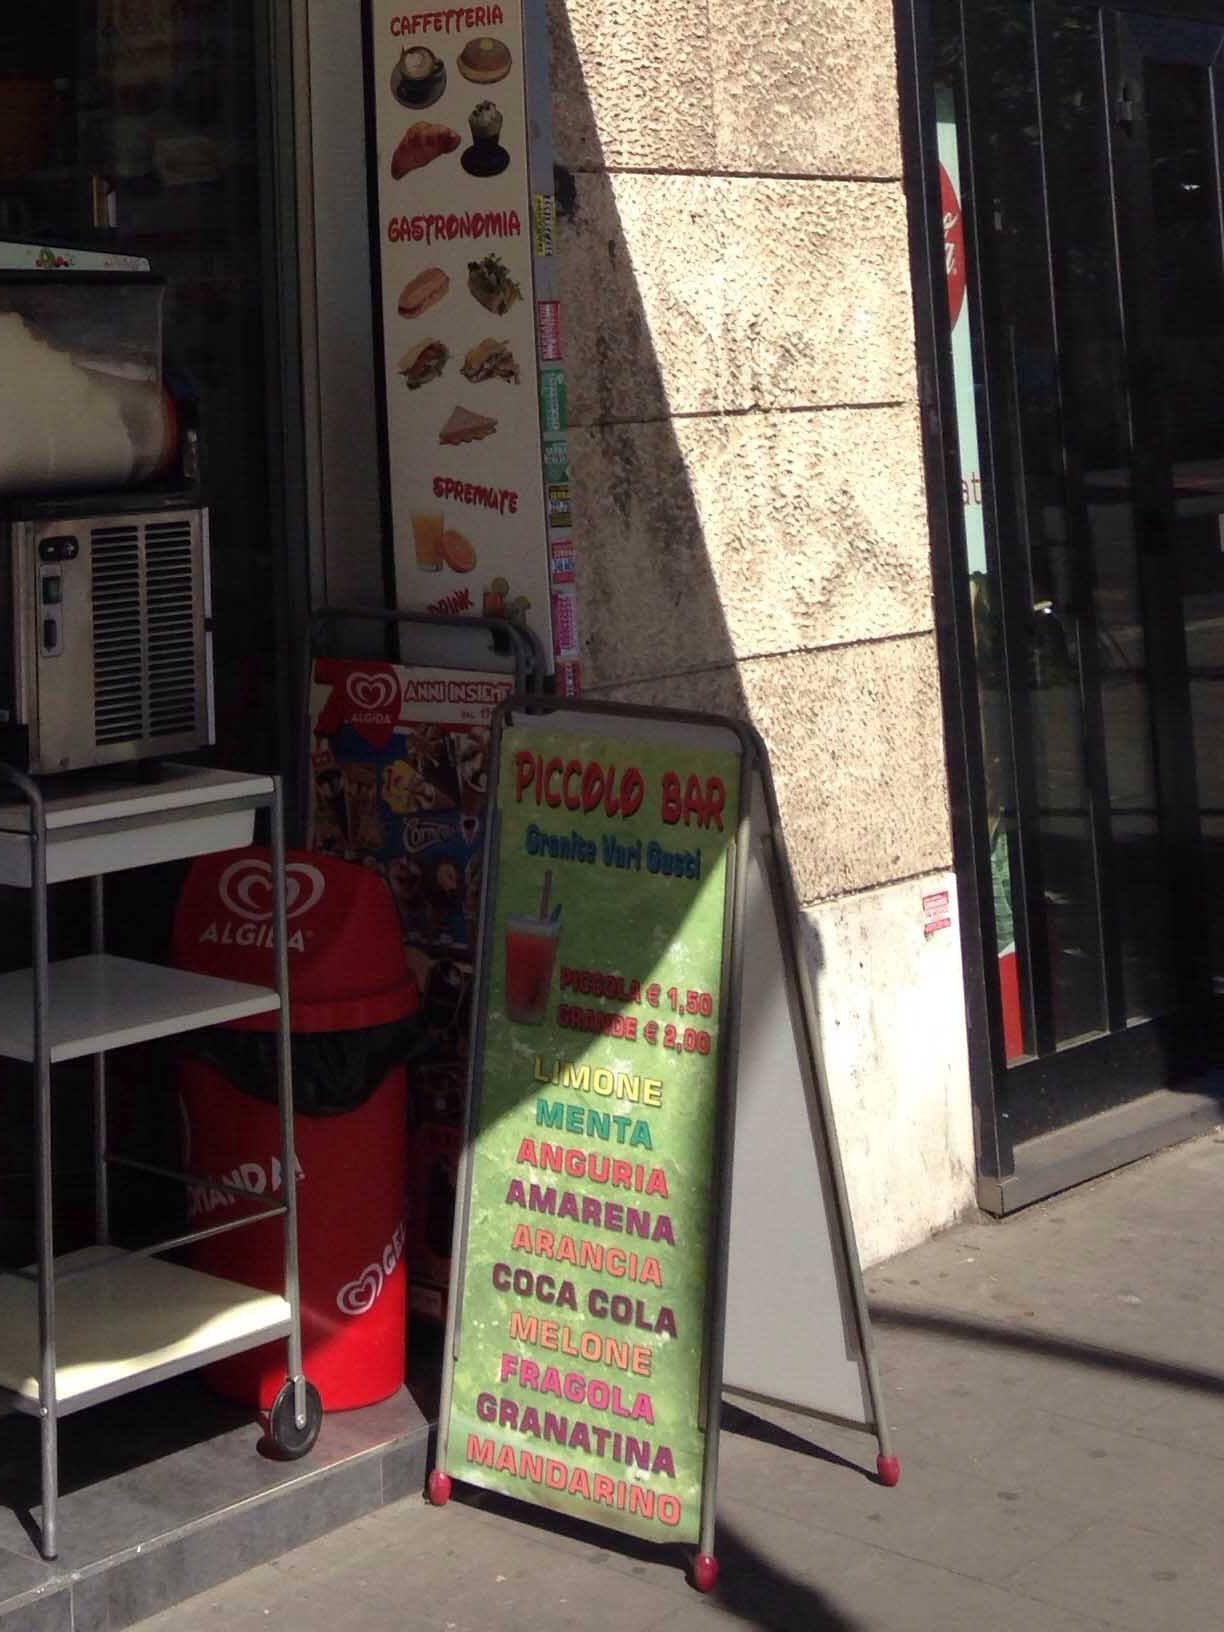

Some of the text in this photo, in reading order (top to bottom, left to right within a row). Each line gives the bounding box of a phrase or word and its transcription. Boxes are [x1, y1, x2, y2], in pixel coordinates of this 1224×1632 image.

[390, 4, 504, 37] CAFFETTERIA
[388, 210, 521, 246] GASTRONOMIA
[432, 476, 519, 515] SPREMUTE
[404, 680, 445, 703] ANNI
[516, 749, 726, 832] PICCOLO BAR
[602, 834, 642, 871] Vari
[560, 967, 642, 1004] PICCOLA
[646, 983, 662, 1009] €
[558, 1003, 638, 1041] GRANDE
[643, 1020, 660, 1046] €
[534, 1057, 664, 1107] LIMONE
[535, 1098, 654, 1150] MENTA
[517, 1137, 669, 1199] ANGURIA
[506, 1178, 676, 1245] AMARENA
[512, 1223, 663, 1288] ARANCIA
[492, 1261, 678, 1338] COCA COLA
[510, 1312, 653, 1377] MELONE
[500, 1353, 655, 1425] FRAGOLA
[476, 1392, 677, 1479] GRANATINA
[467, 1433, 681, 1526] MANDARINO
